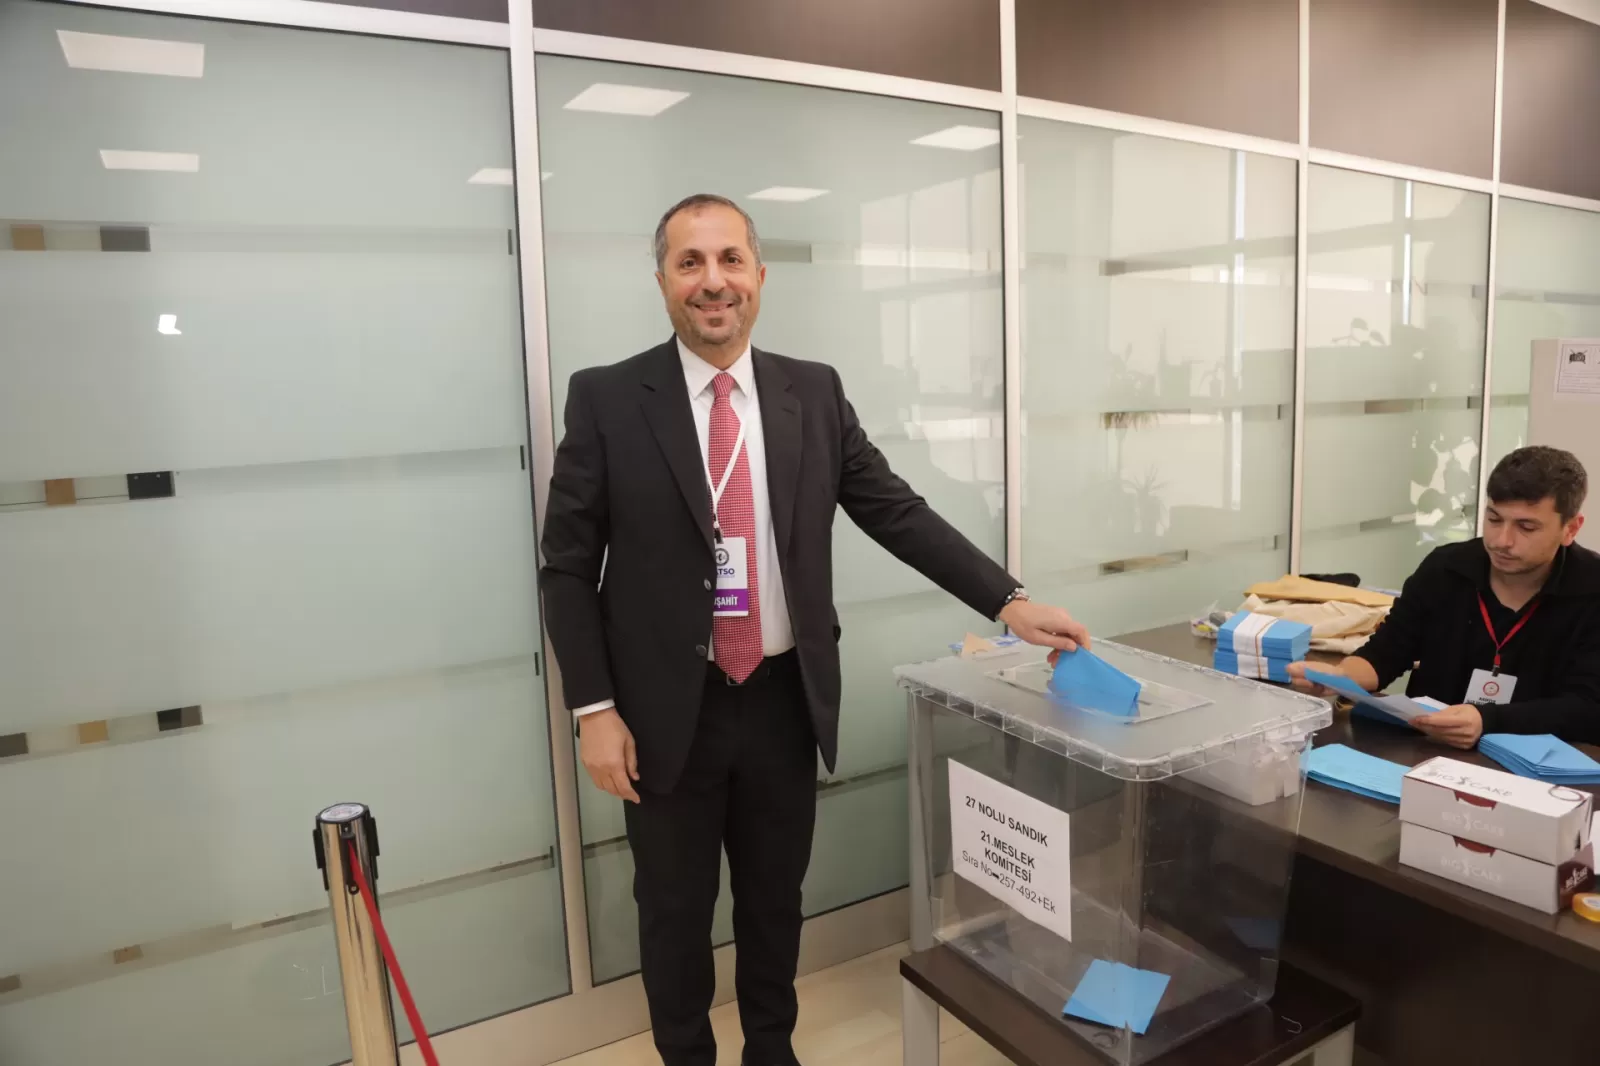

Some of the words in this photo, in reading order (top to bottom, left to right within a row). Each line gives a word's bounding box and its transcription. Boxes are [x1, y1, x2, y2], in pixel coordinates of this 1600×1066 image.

[714, 594, 738, 608] ŞAHİT
[965, 796, 976, 808] 27
[978, 802, 1005, 824] NOLU
[1008, 818, 1048, 847] SANDIK
[962, 850, 979, 869] Sıra
[984, 848, 1032, 883] KOMİTESİ
